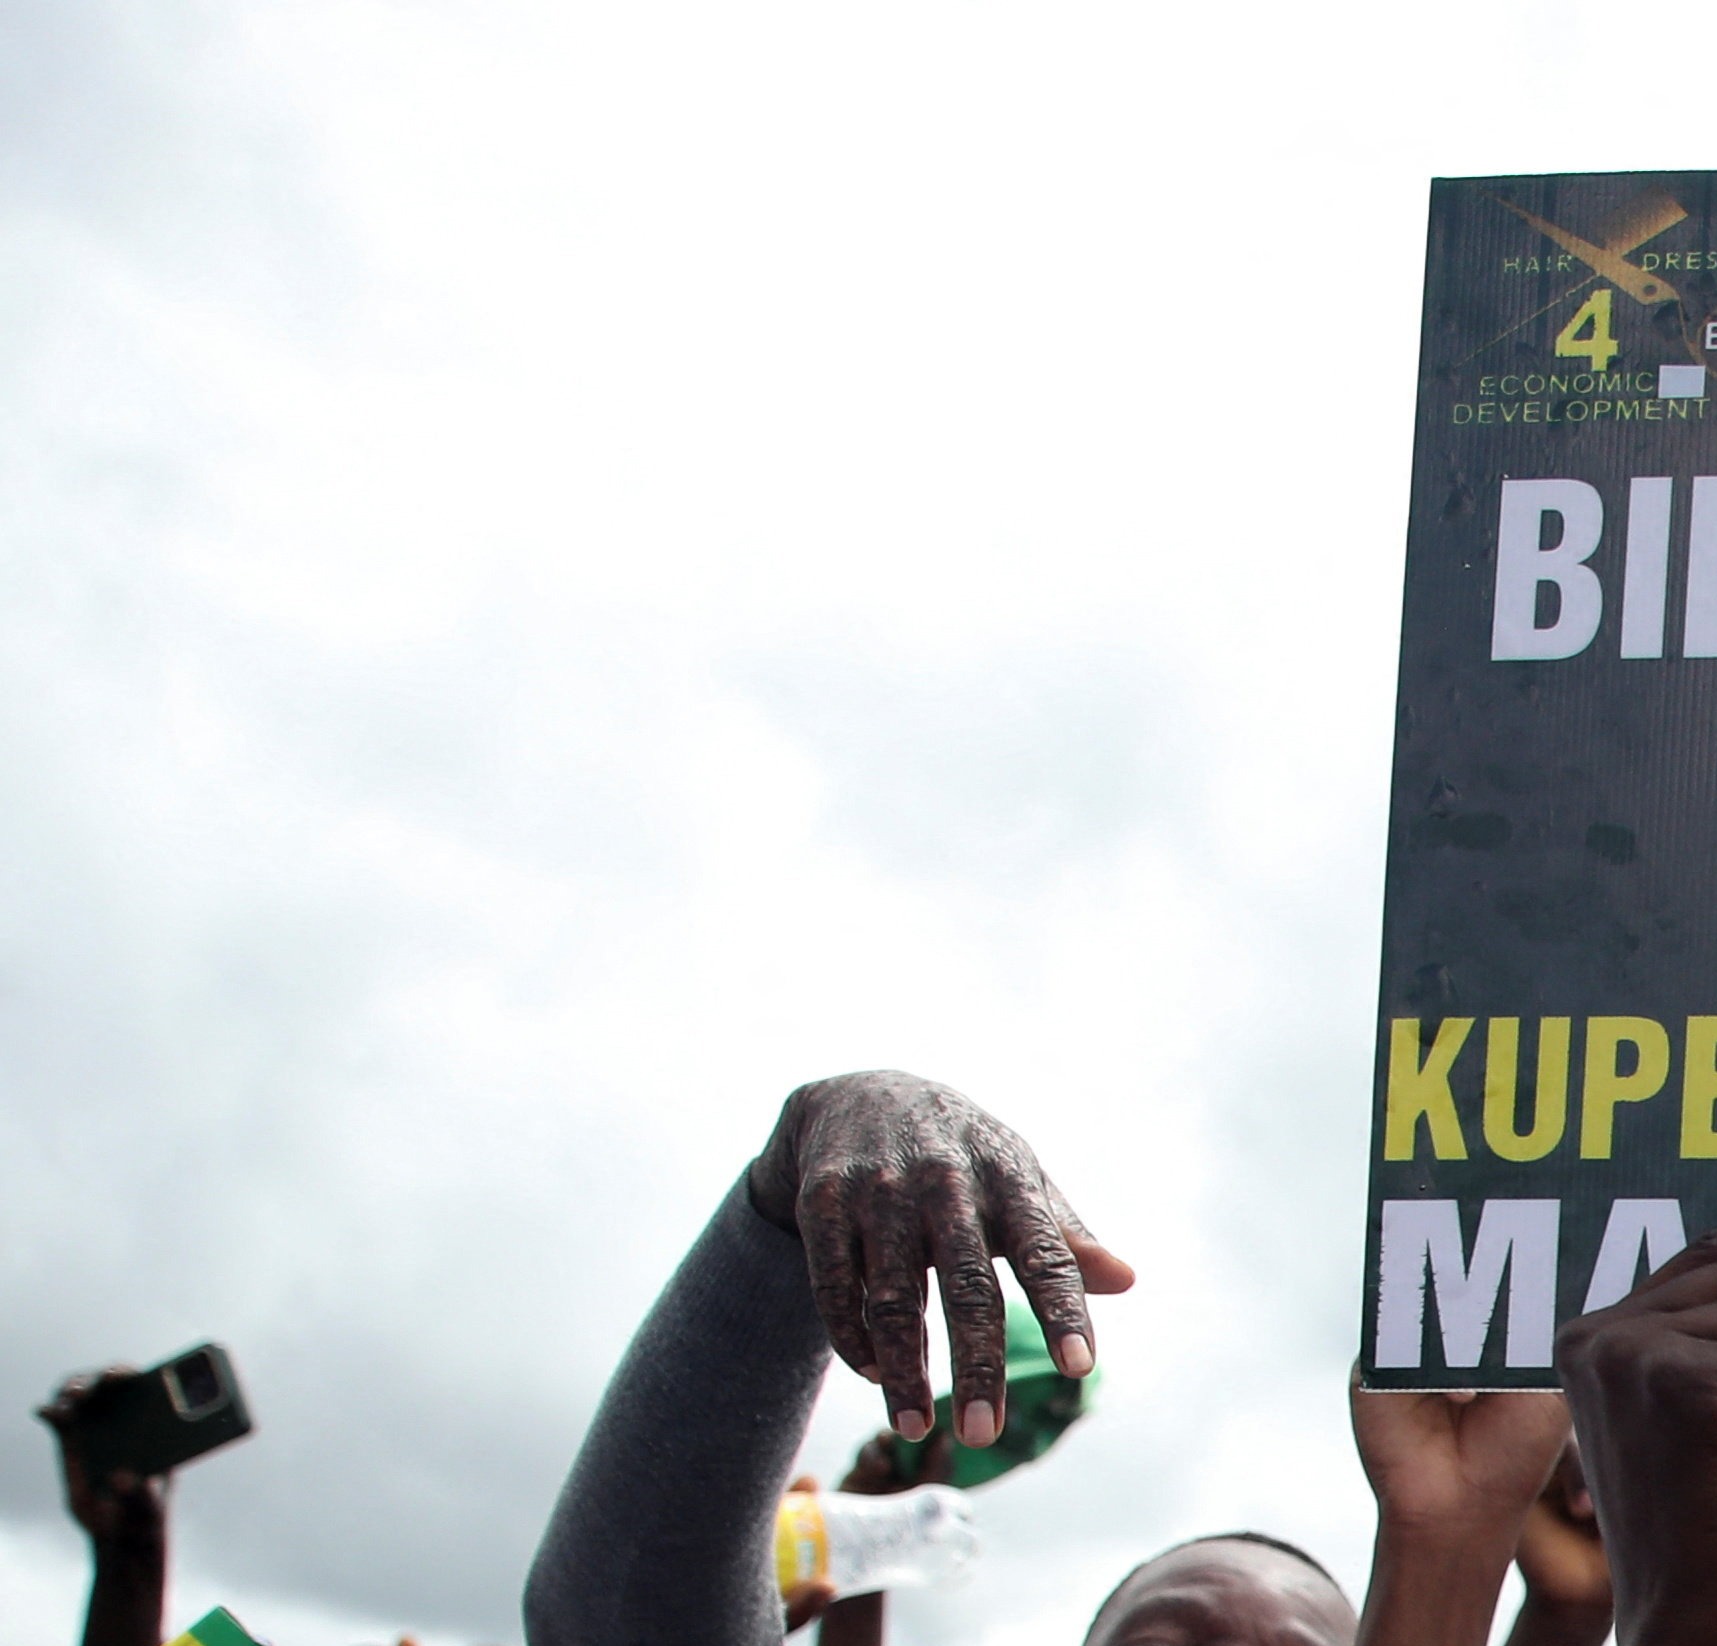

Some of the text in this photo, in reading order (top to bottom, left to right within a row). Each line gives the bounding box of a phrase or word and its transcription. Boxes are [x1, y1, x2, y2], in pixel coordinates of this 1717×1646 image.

[1504, 254, 1575, 274] HAIR
[1555, 289, 1619, 371] 4
[1480, 371, 1654, 396] ECONOMIC
[1454, 398, 1711, 425] DEVELOPMENT
